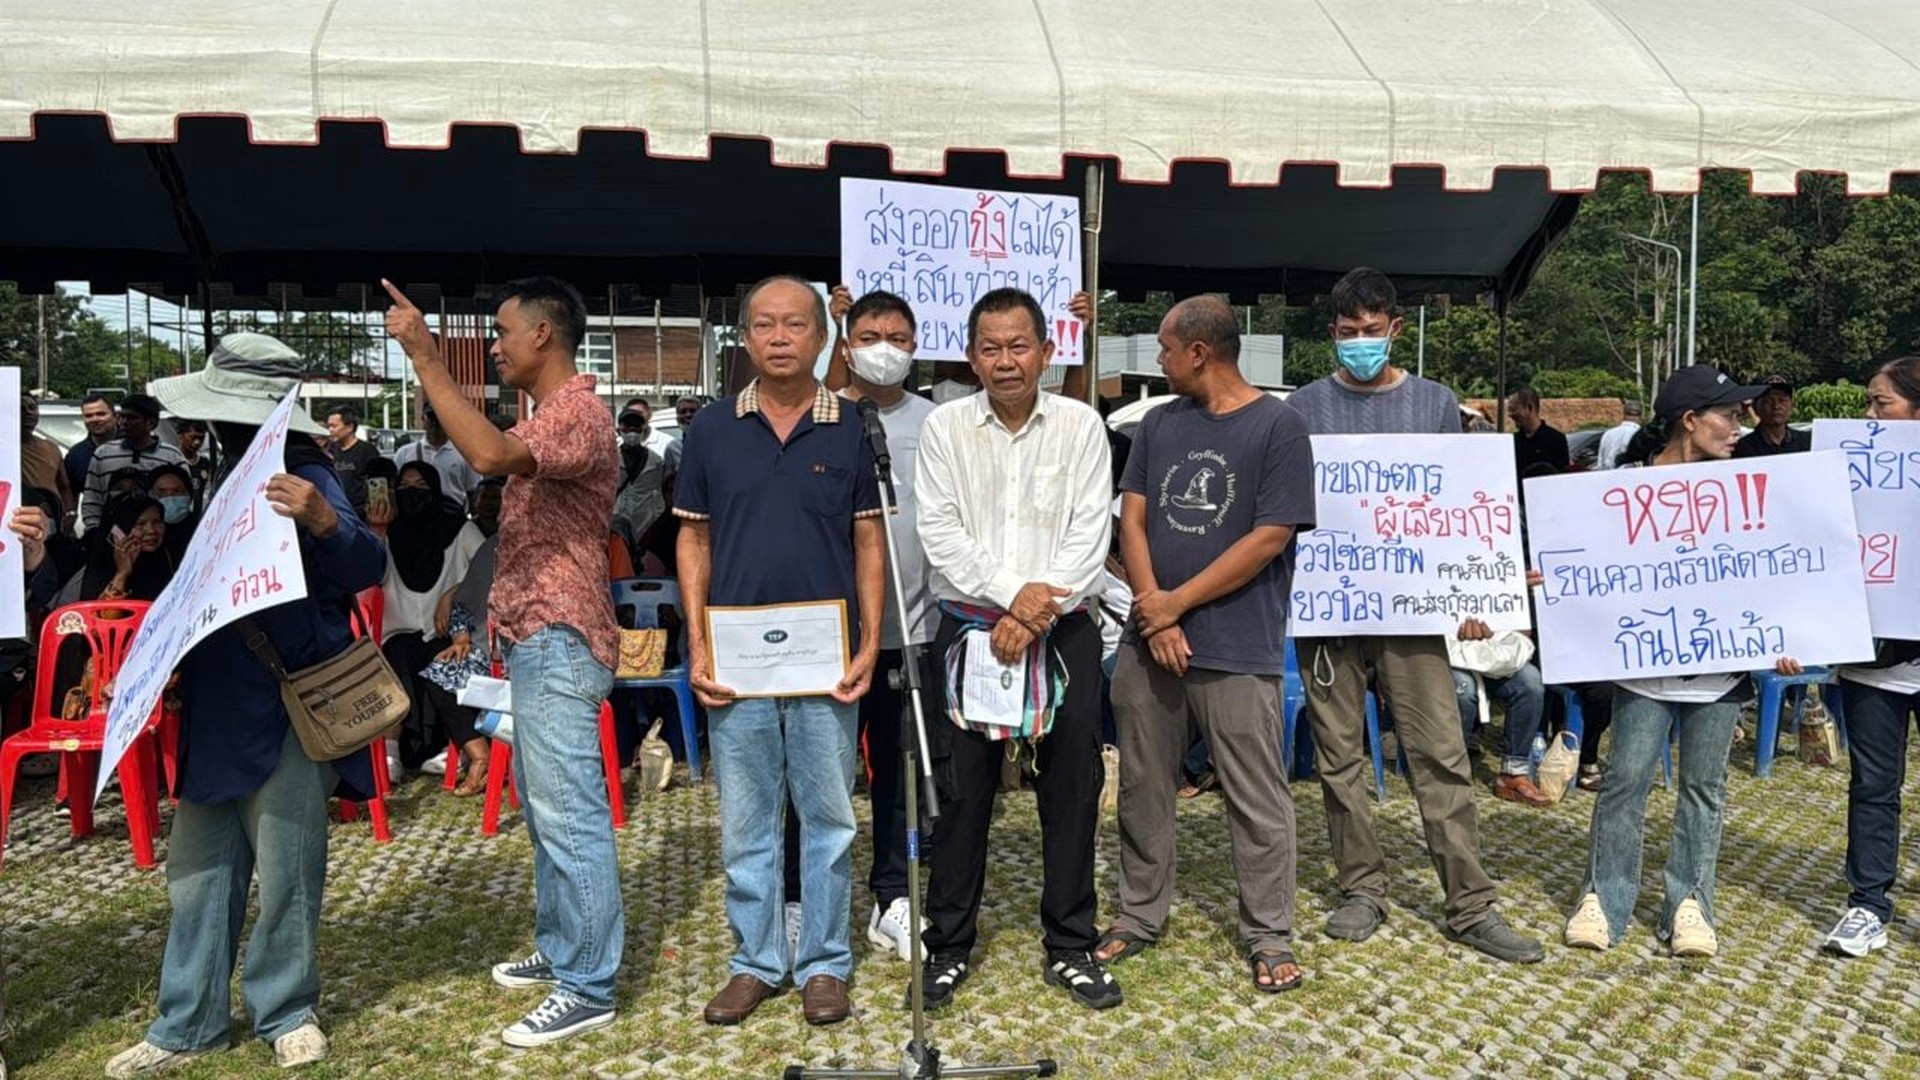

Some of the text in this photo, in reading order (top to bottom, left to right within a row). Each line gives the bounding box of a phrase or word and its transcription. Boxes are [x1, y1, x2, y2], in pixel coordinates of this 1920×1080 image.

[1315, 460, 1443, 495] ายเกษตกร
[1296, 529, 1424, 574] วงโซ่อาชีพ
[1538, 542, 1825, 606] โยนความรับผิดชอบ
[1290, 575, 1383, 622] ยวข้อง
[1614, 606, 1785, 670] กันได้แล้ว
[342, 694, 393, 728] YOURSELF
[352, 690, 381, 712] FREE
